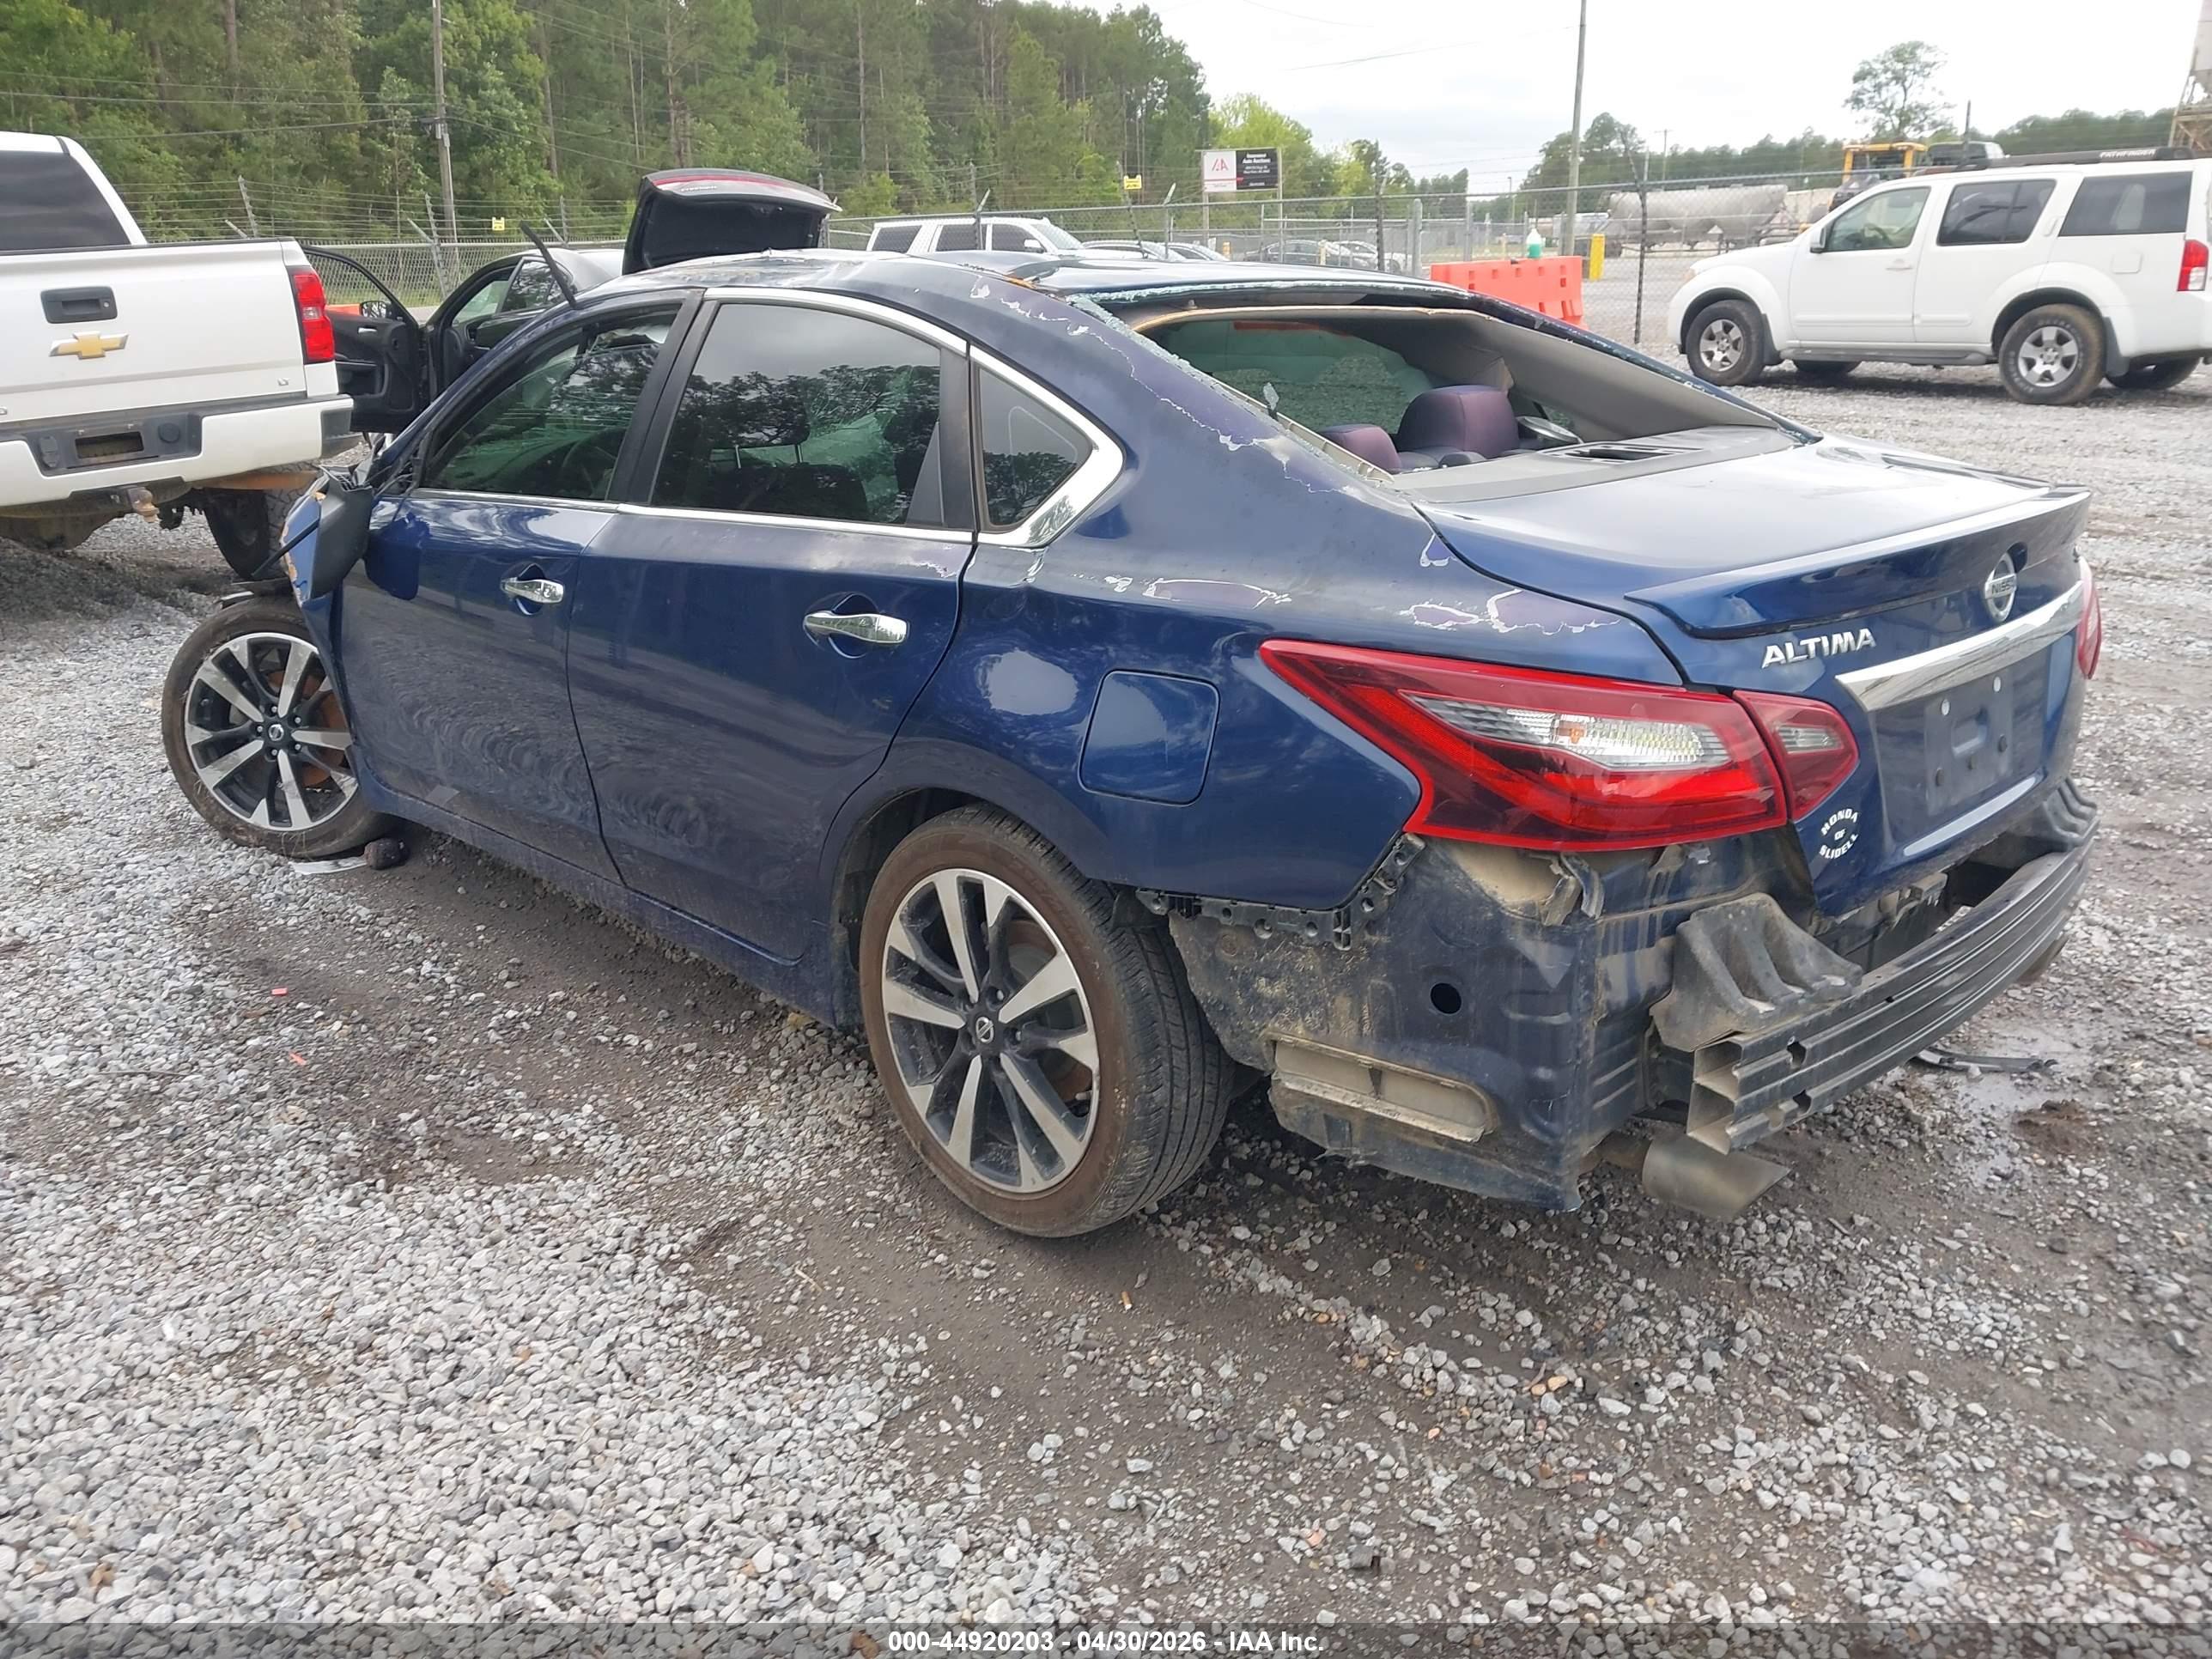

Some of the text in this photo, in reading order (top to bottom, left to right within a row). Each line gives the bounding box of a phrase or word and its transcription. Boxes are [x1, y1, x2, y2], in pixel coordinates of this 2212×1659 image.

[2100, 149, 2156, 158] PATHFINDER
[1991, 578, 2015, 594] NISS
[1761, 629, 1876, 669] ALTIMA
[1820, 808, 1858, 836] HONDA
[1834, 829, 1846, 841] OF
[1819, 834, 1858, 859] SLIDELL
